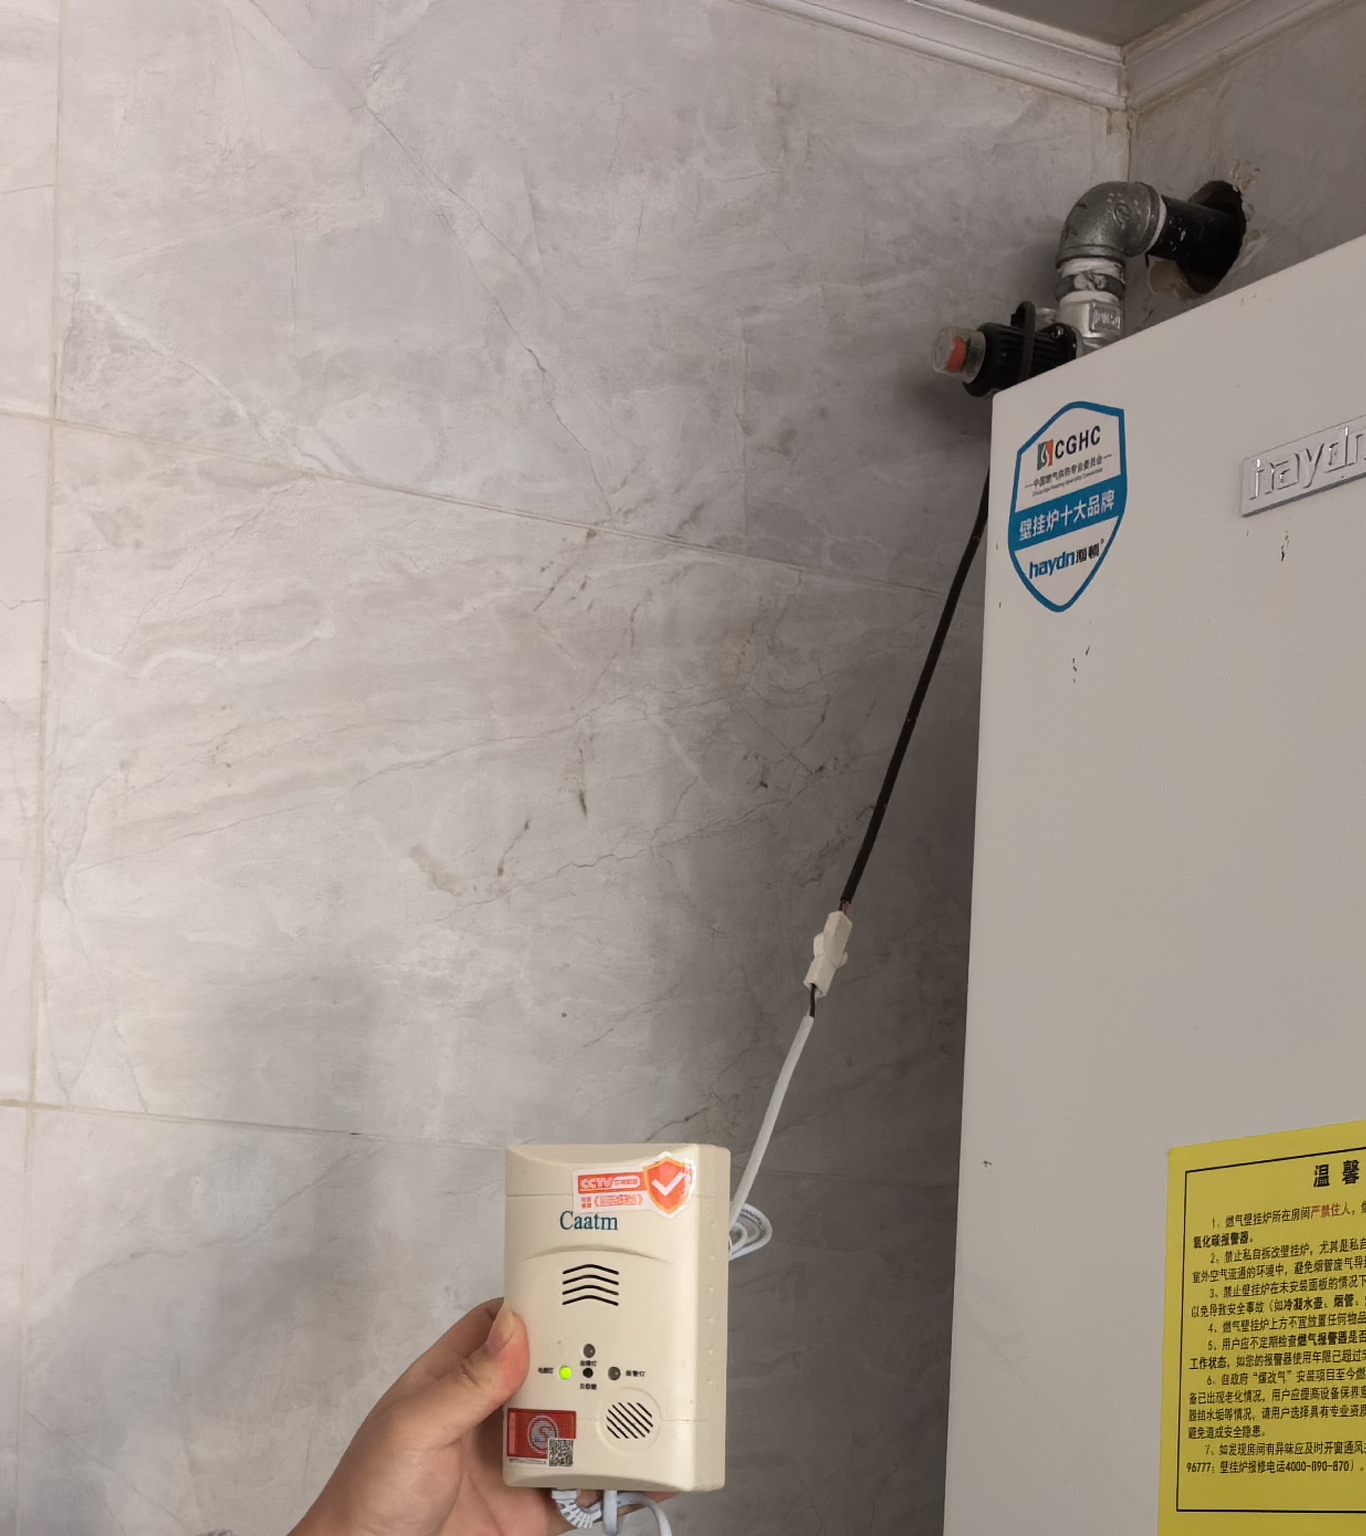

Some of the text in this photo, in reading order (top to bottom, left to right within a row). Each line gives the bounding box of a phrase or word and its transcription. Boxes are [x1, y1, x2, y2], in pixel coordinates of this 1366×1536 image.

[1055, 425, 1101, 459] CGHC
[1019, 490, 1115, 541] 壁挂炉十大品牌
[559, 1210, 619, 1231] Caatm
